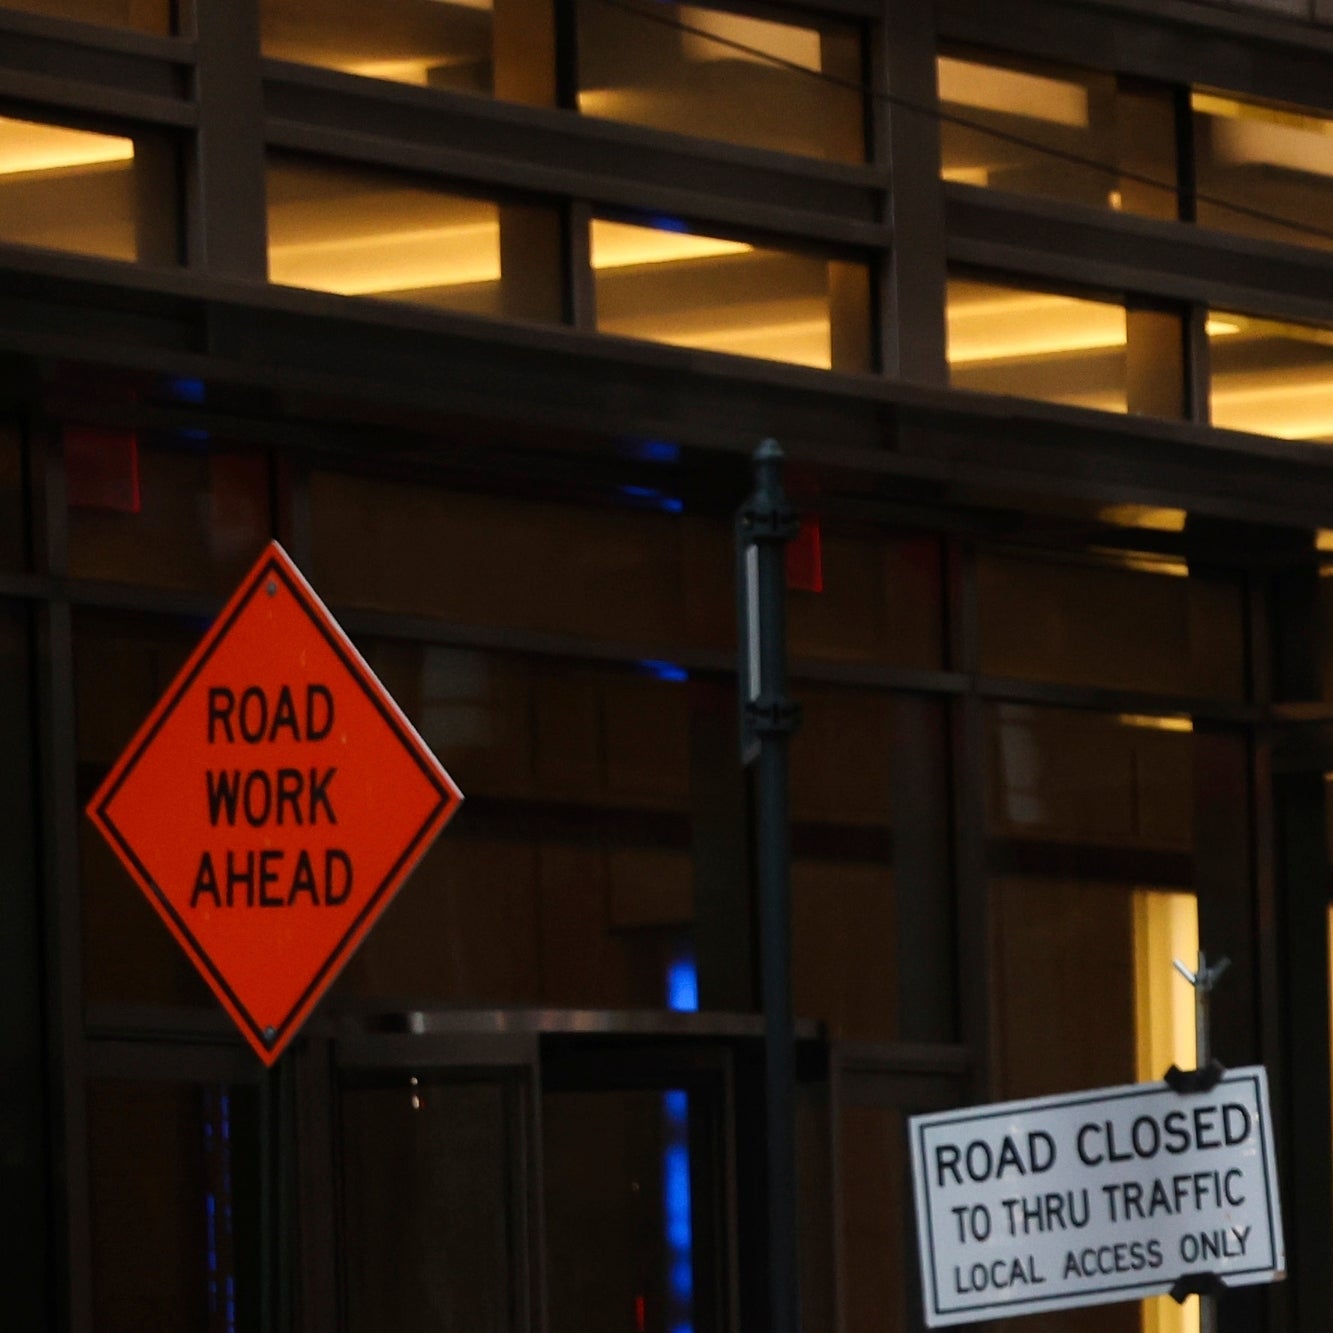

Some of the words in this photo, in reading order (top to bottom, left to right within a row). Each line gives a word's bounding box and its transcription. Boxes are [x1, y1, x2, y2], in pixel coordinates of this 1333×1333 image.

[206, 685, 335, 744] ROAD
[205, 767, 338, 828] WORK
[189, 849, 354, 908] AHEAD
[935, 1130, 1057, 1188] ROAD
[1076, 1102, 1252, 1167] CLOSED
[951, 1205, 991, 1244] TO
[1002, 1188, 1090, 1236] THRU
[1102, 1168, 1246, 1224] TRAFFIC
[954, 1256, 1045, 1295] LOCAL
[1062, 1240, 1164, 1280] ACCESS
[1179, 1226, 1252, 1264] ONLY
